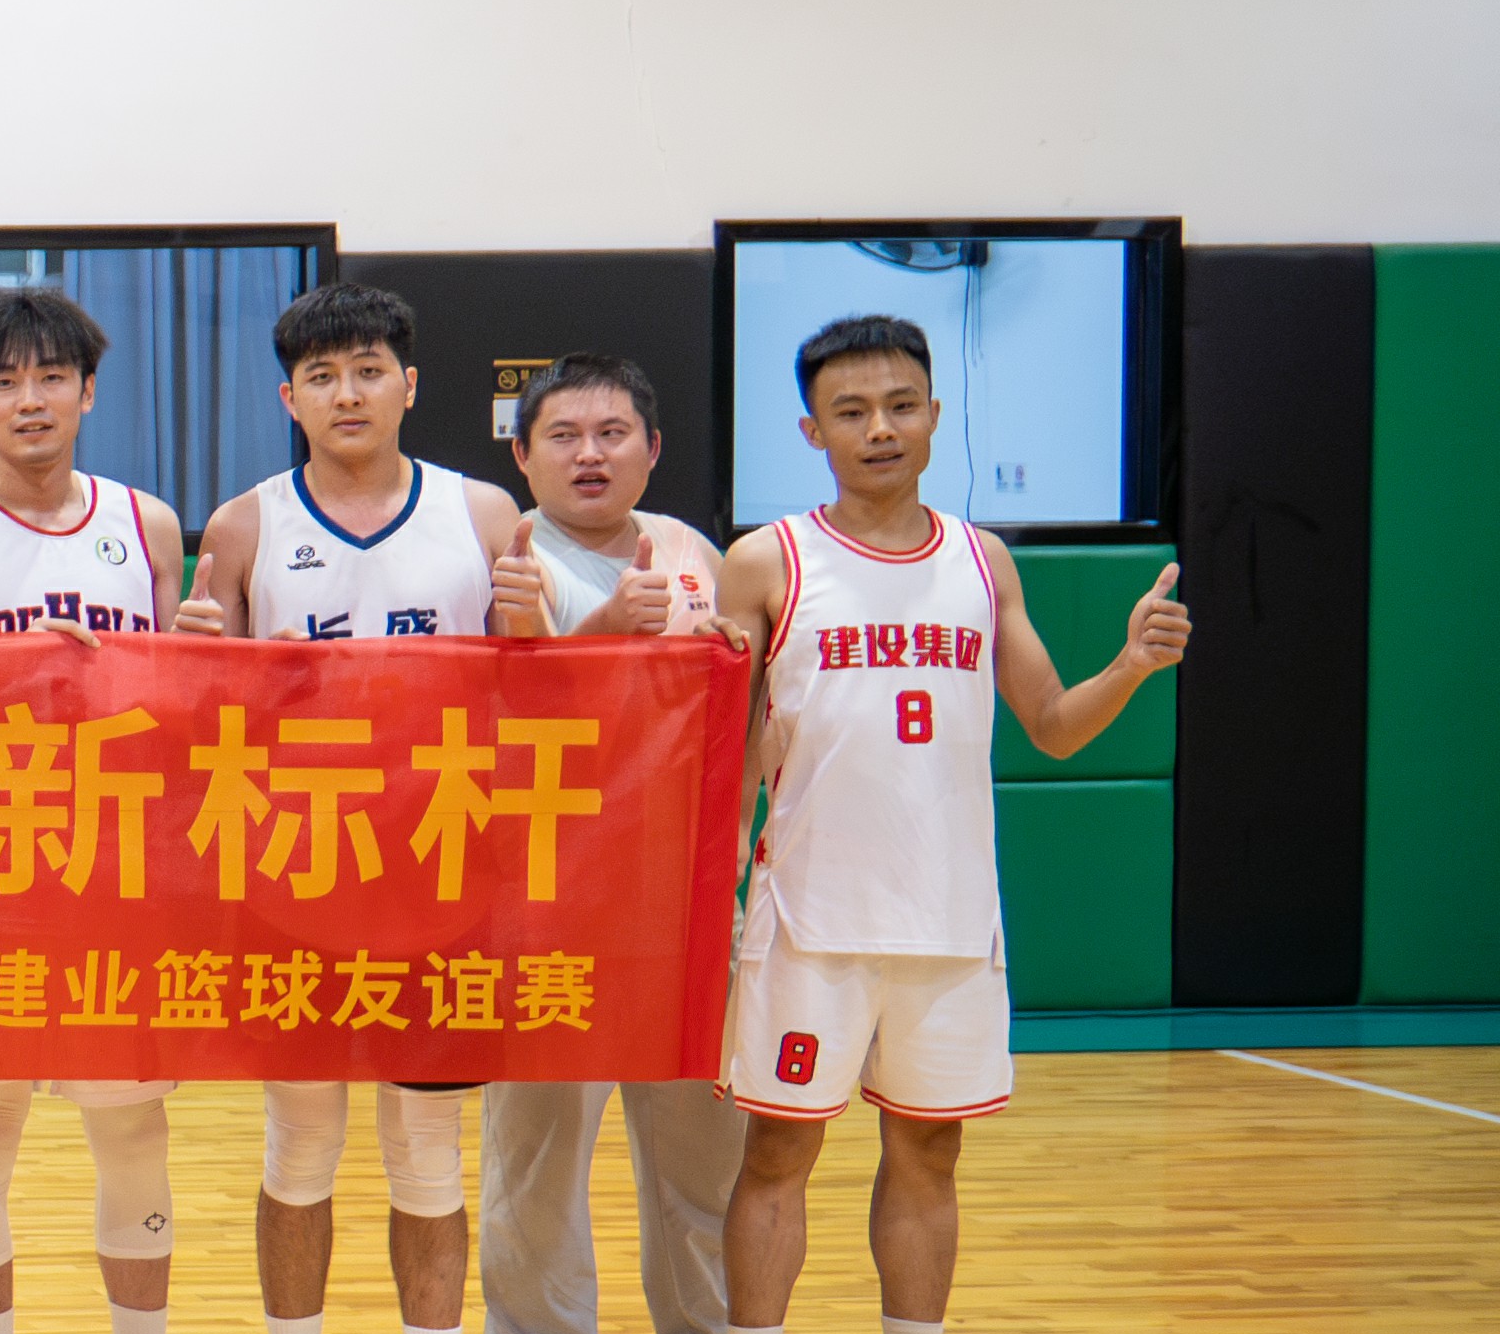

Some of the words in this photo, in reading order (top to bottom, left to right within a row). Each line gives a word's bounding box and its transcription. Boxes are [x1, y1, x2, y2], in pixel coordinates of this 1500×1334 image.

[815, 623, 983, 672] 建设集团
[896, 689, 933, 744] 8
[776, 1032, 820, 1085] 8
